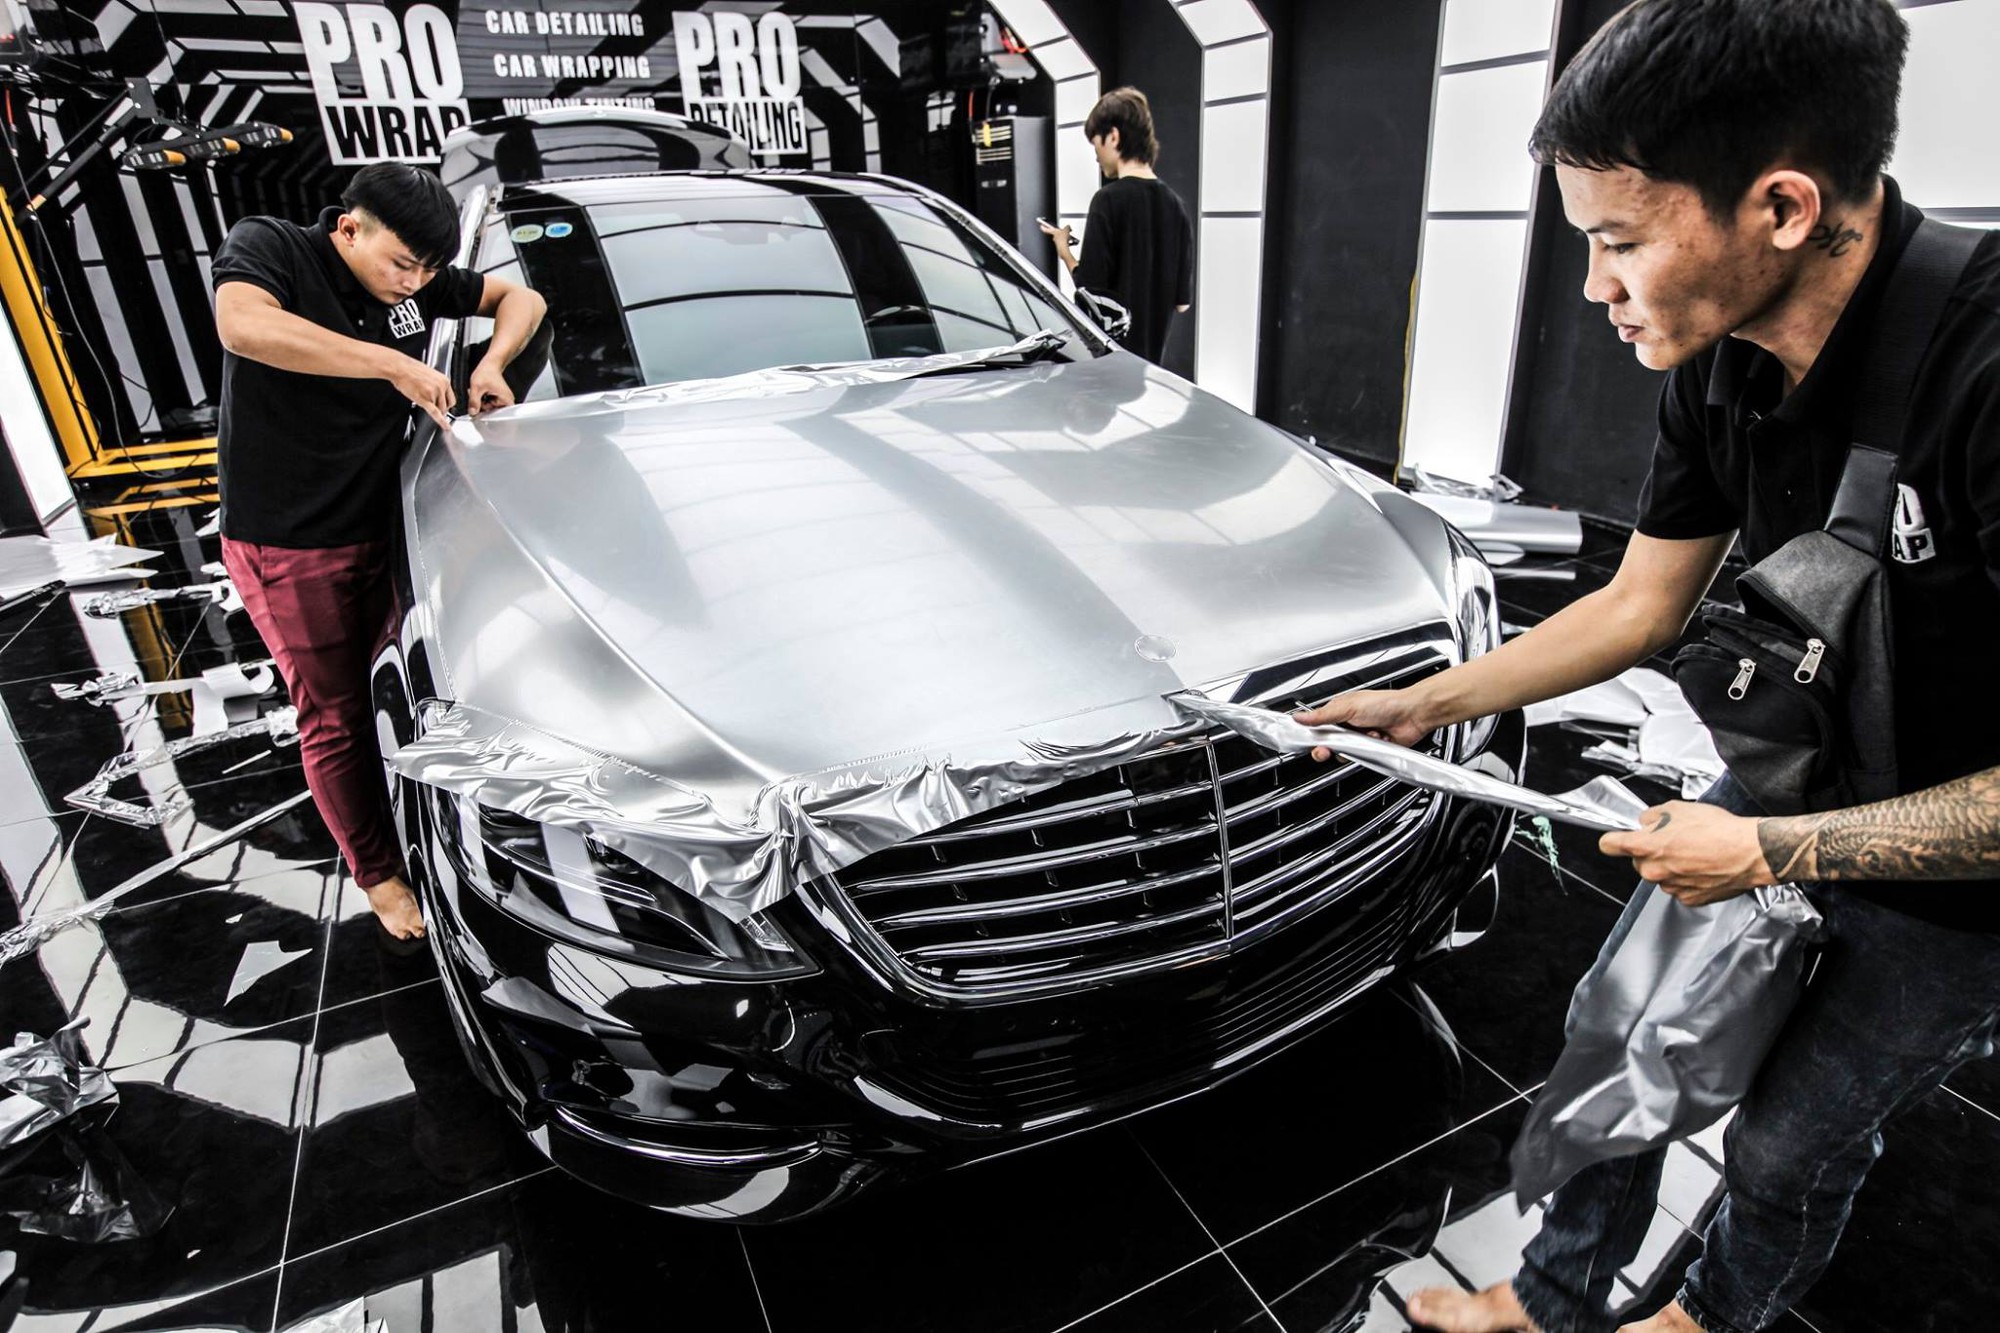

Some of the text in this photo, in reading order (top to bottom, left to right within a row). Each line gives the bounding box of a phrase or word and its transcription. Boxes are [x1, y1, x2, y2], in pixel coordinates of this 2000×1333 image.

[293, 2, 464, 101] PRO
[485, 10, 645, 36] CAR DETAILING
[493, 54, 650, 78] CAR WRAPPING
[671, 11, 801, 99] PRO
